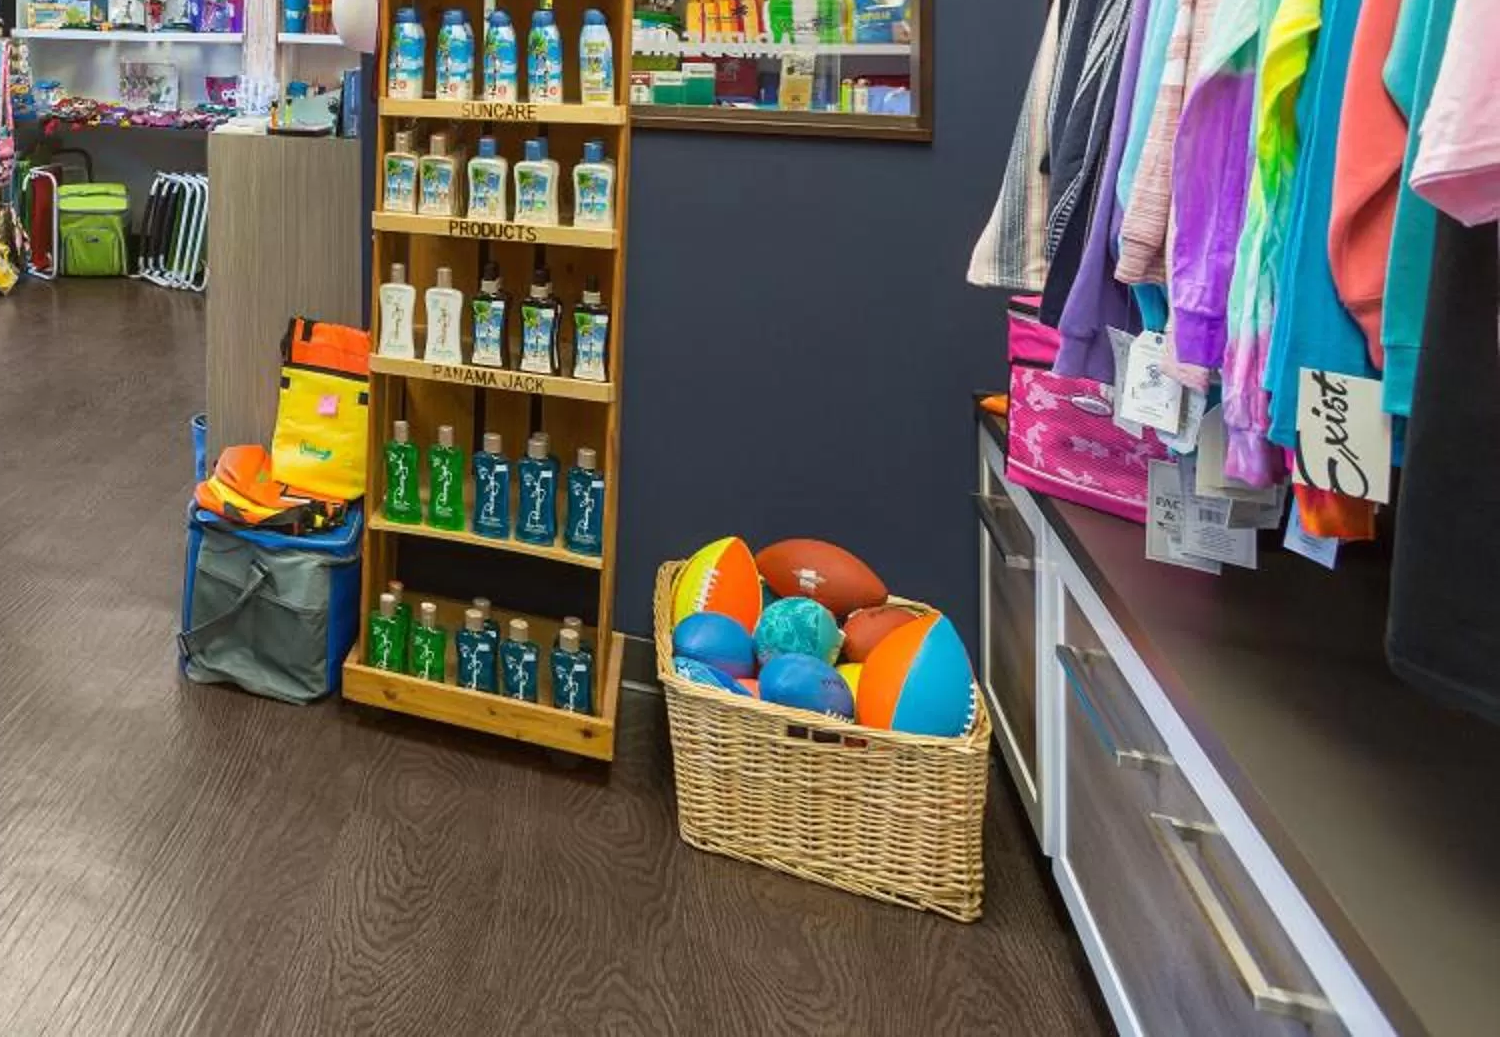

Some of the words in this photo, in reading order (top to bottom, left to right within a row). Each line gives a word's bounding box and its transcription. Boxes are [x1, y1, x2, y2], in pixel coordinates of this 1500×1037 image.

[460, 102, 538, 120] SUNCARE
[449, 219, 538, 242] PRODUCTS
[431, 364, 498, 386] PANAMA
[502, 374, 546, 394] JACK
